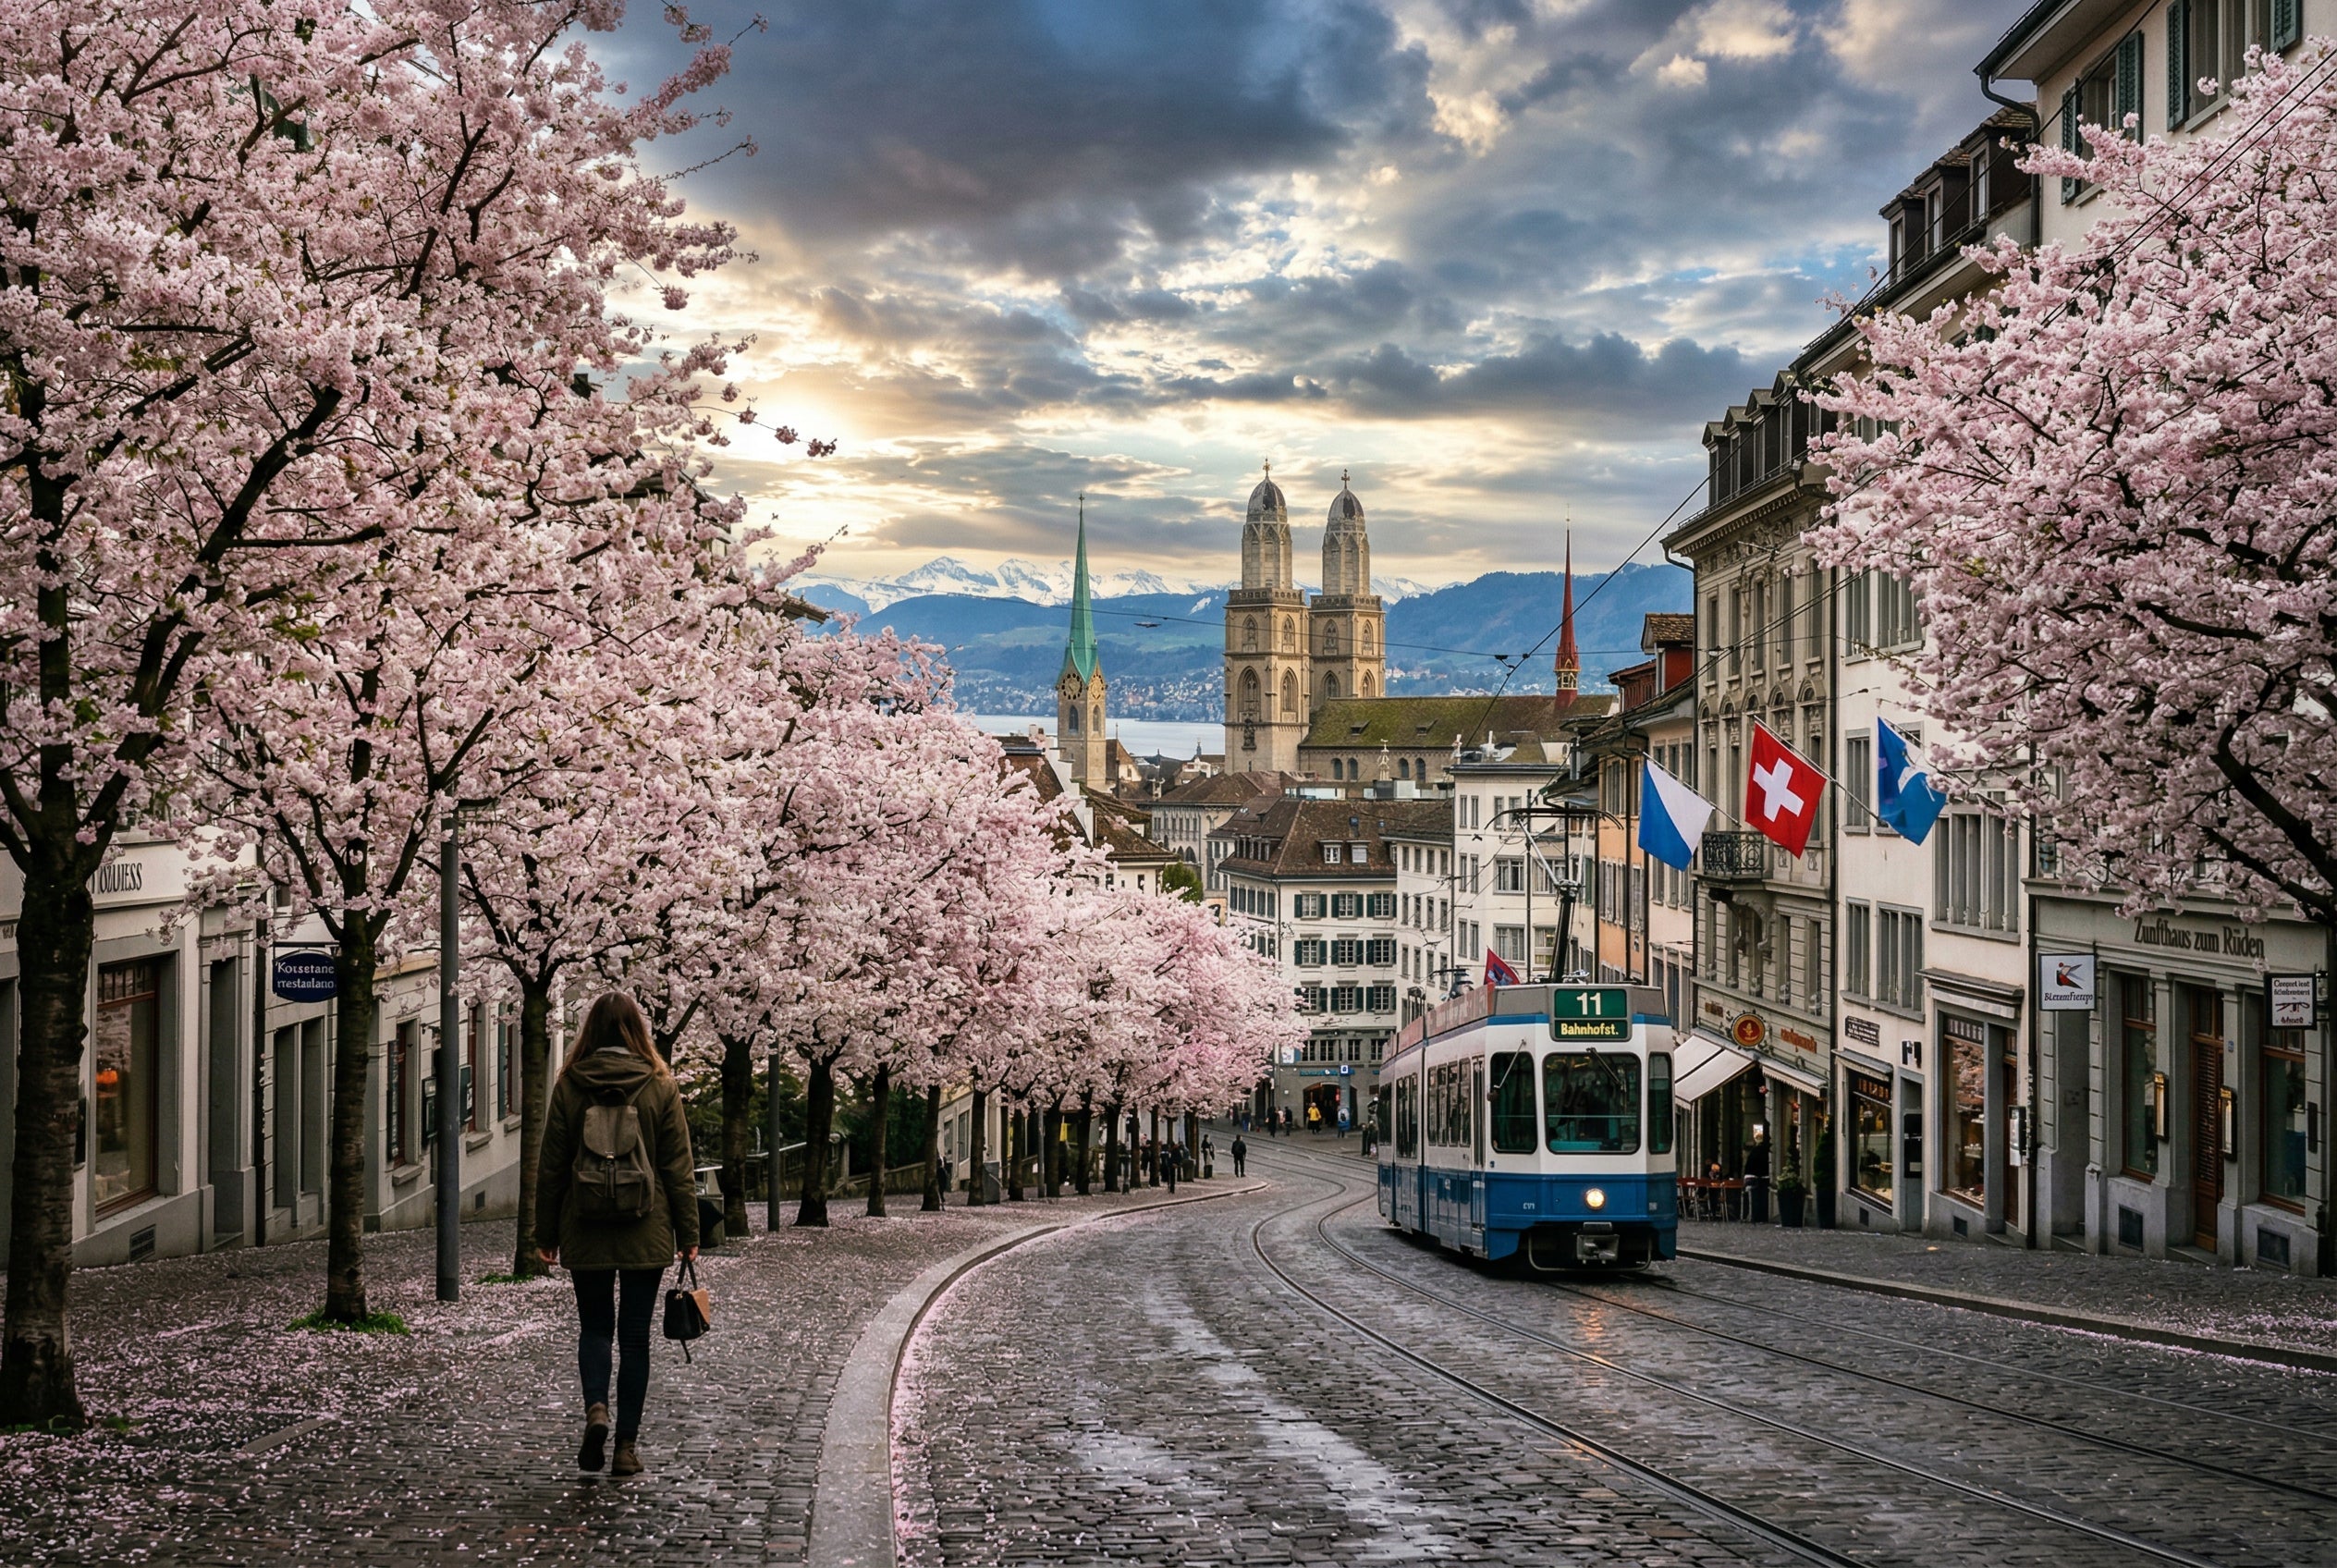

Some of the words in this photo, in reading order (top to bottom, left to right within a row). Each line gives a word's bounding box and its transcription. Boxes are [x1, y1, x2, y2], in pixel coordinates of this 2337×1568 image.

[2134, 916, 2192, 949] Zunfthaus
[2194, 931, 2220, 953] zum
[2222, 925, 2265, 959] Rüden
[1576, 992, 1602, 1015] 11
[1560, 1023, 1620, 1035] Bahnhofst.
